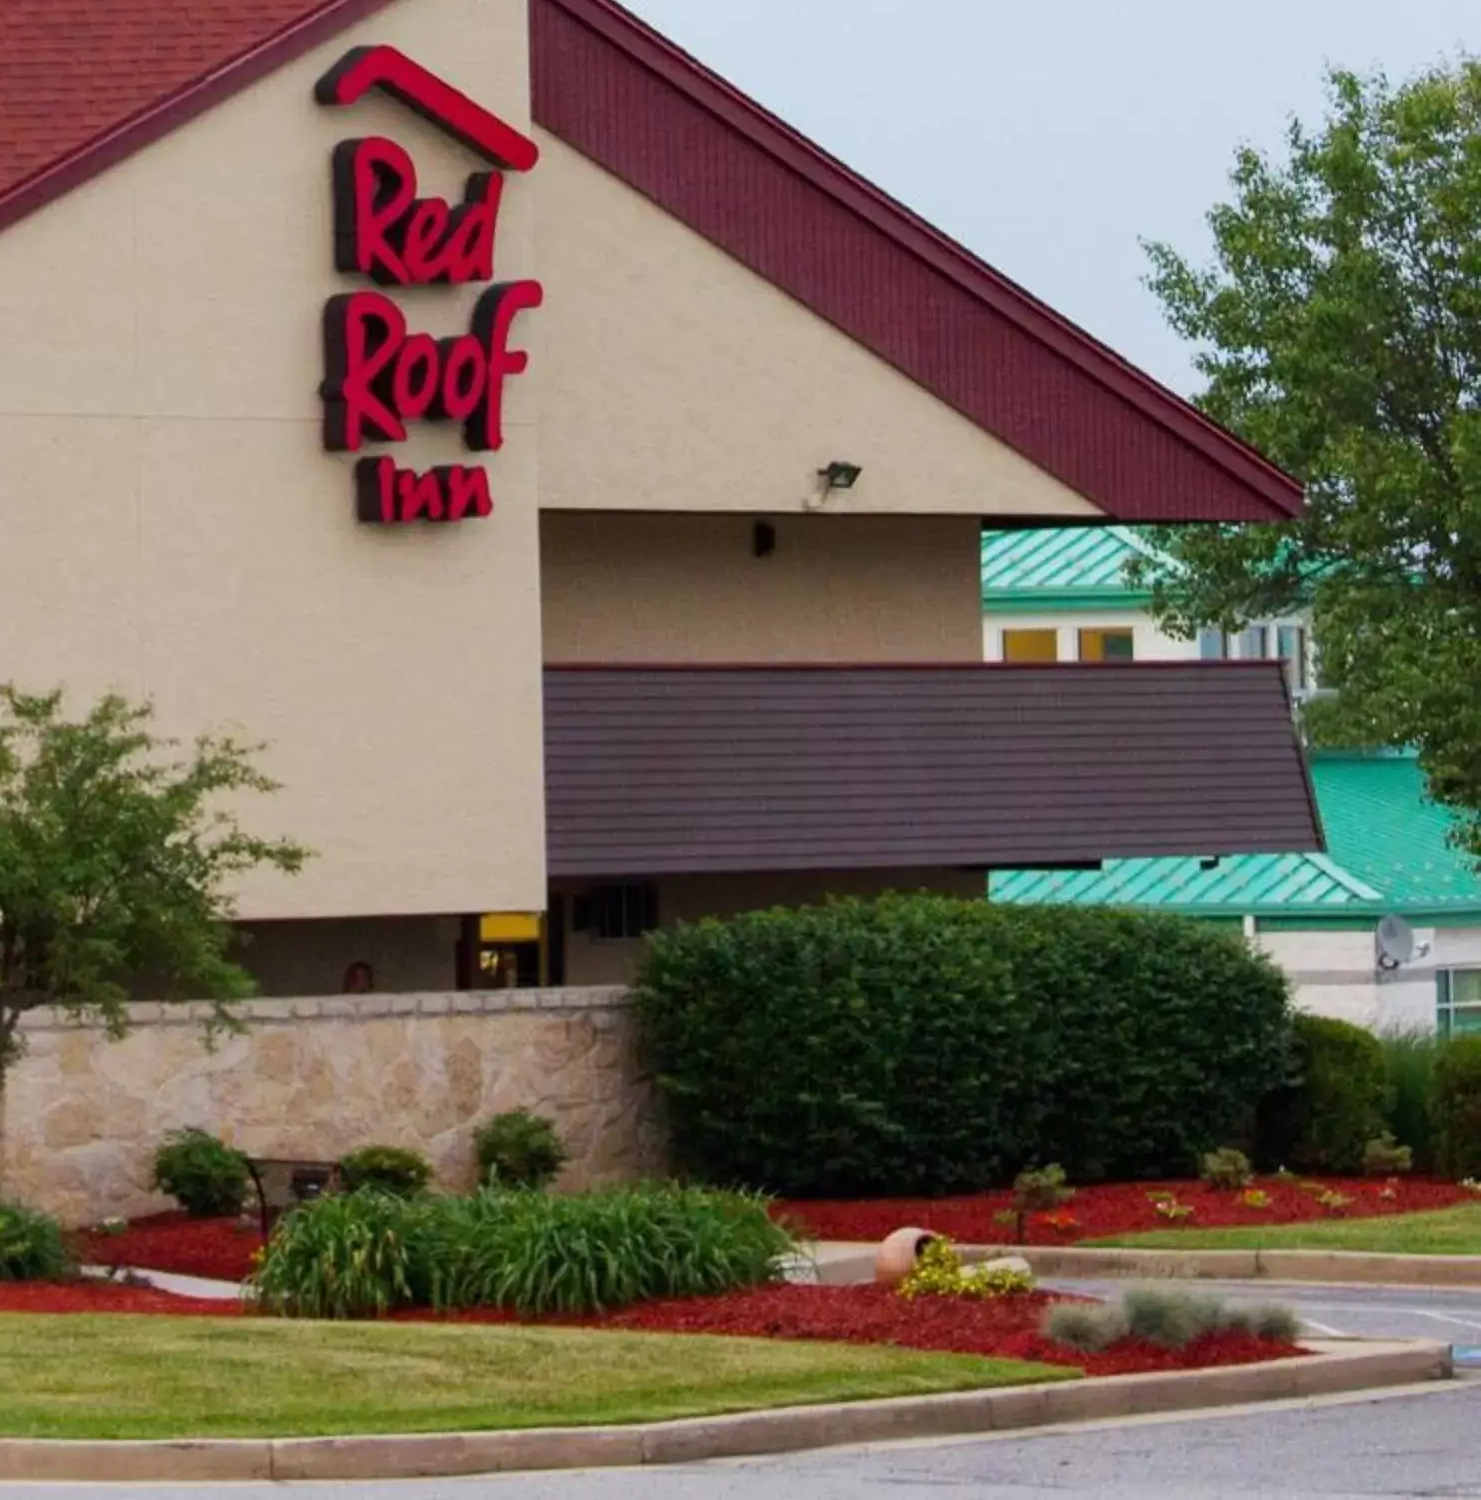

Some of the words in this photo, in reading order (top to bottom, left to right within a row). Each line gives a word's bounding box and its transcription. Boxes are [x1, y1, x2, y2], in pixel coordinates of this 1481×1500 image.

[354, 136, 504, 285] Red
[341, 280, 543, 452] Roof
[377, 456, 493, 523] Inn
